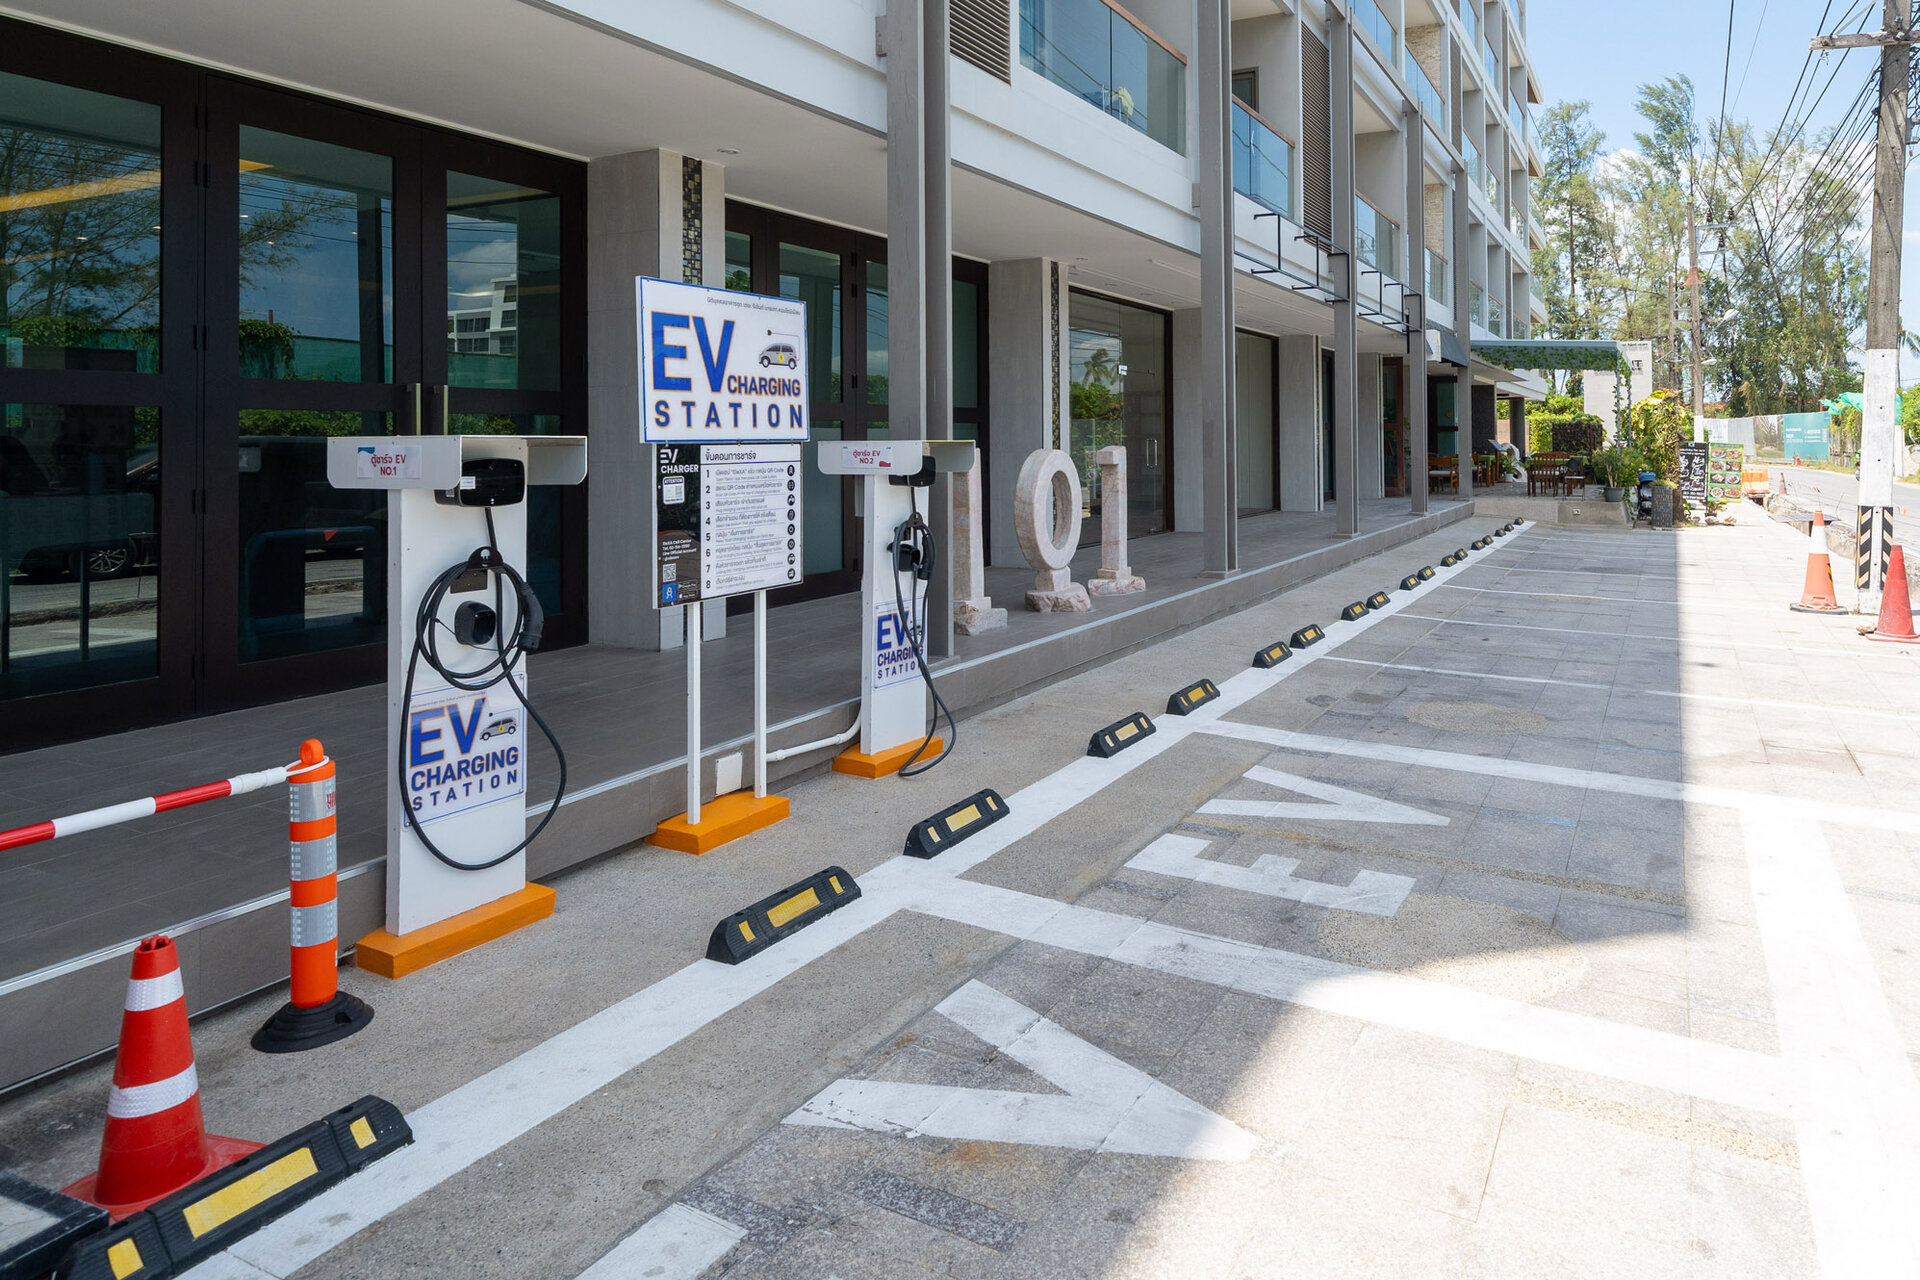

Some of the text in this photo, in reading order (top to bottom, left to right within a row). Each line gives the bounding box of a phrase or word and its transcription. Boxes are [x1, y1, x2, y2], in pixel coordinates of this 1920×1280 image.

[651, 310, 801, 396] EV CHARGING
[654, 400, 802, 428] STATION
[660, 449, 678, 463] EV
[705, 449, 756, 461] ขั้นตอนการชาร์จ
[853, 450, 870, 458] ตู้ชาร์จ
[370, 454, 406, 467] ตู้ชาร์จ EV
[380, 467, 397, 476] NO.1
[661, 464, 699, 474] CHARGER
[706, 470, 710, 478] 1
[706, 501, 710, 509] 3
[706, 517, 710, 525] 4
[706, 533, 710, 541] 5
[706, 548, 710, 557] 6
[706, 565, 710, 573] 7
[706, 580, 711, 588] 8
[877, 610, 910, 651] EV
[878, 660, 920, 679] STATIO
[410, 697, 486, 768] EV
[411, 746, 519, 792] CHARGING
[412, 769, 518, 811] STATION
